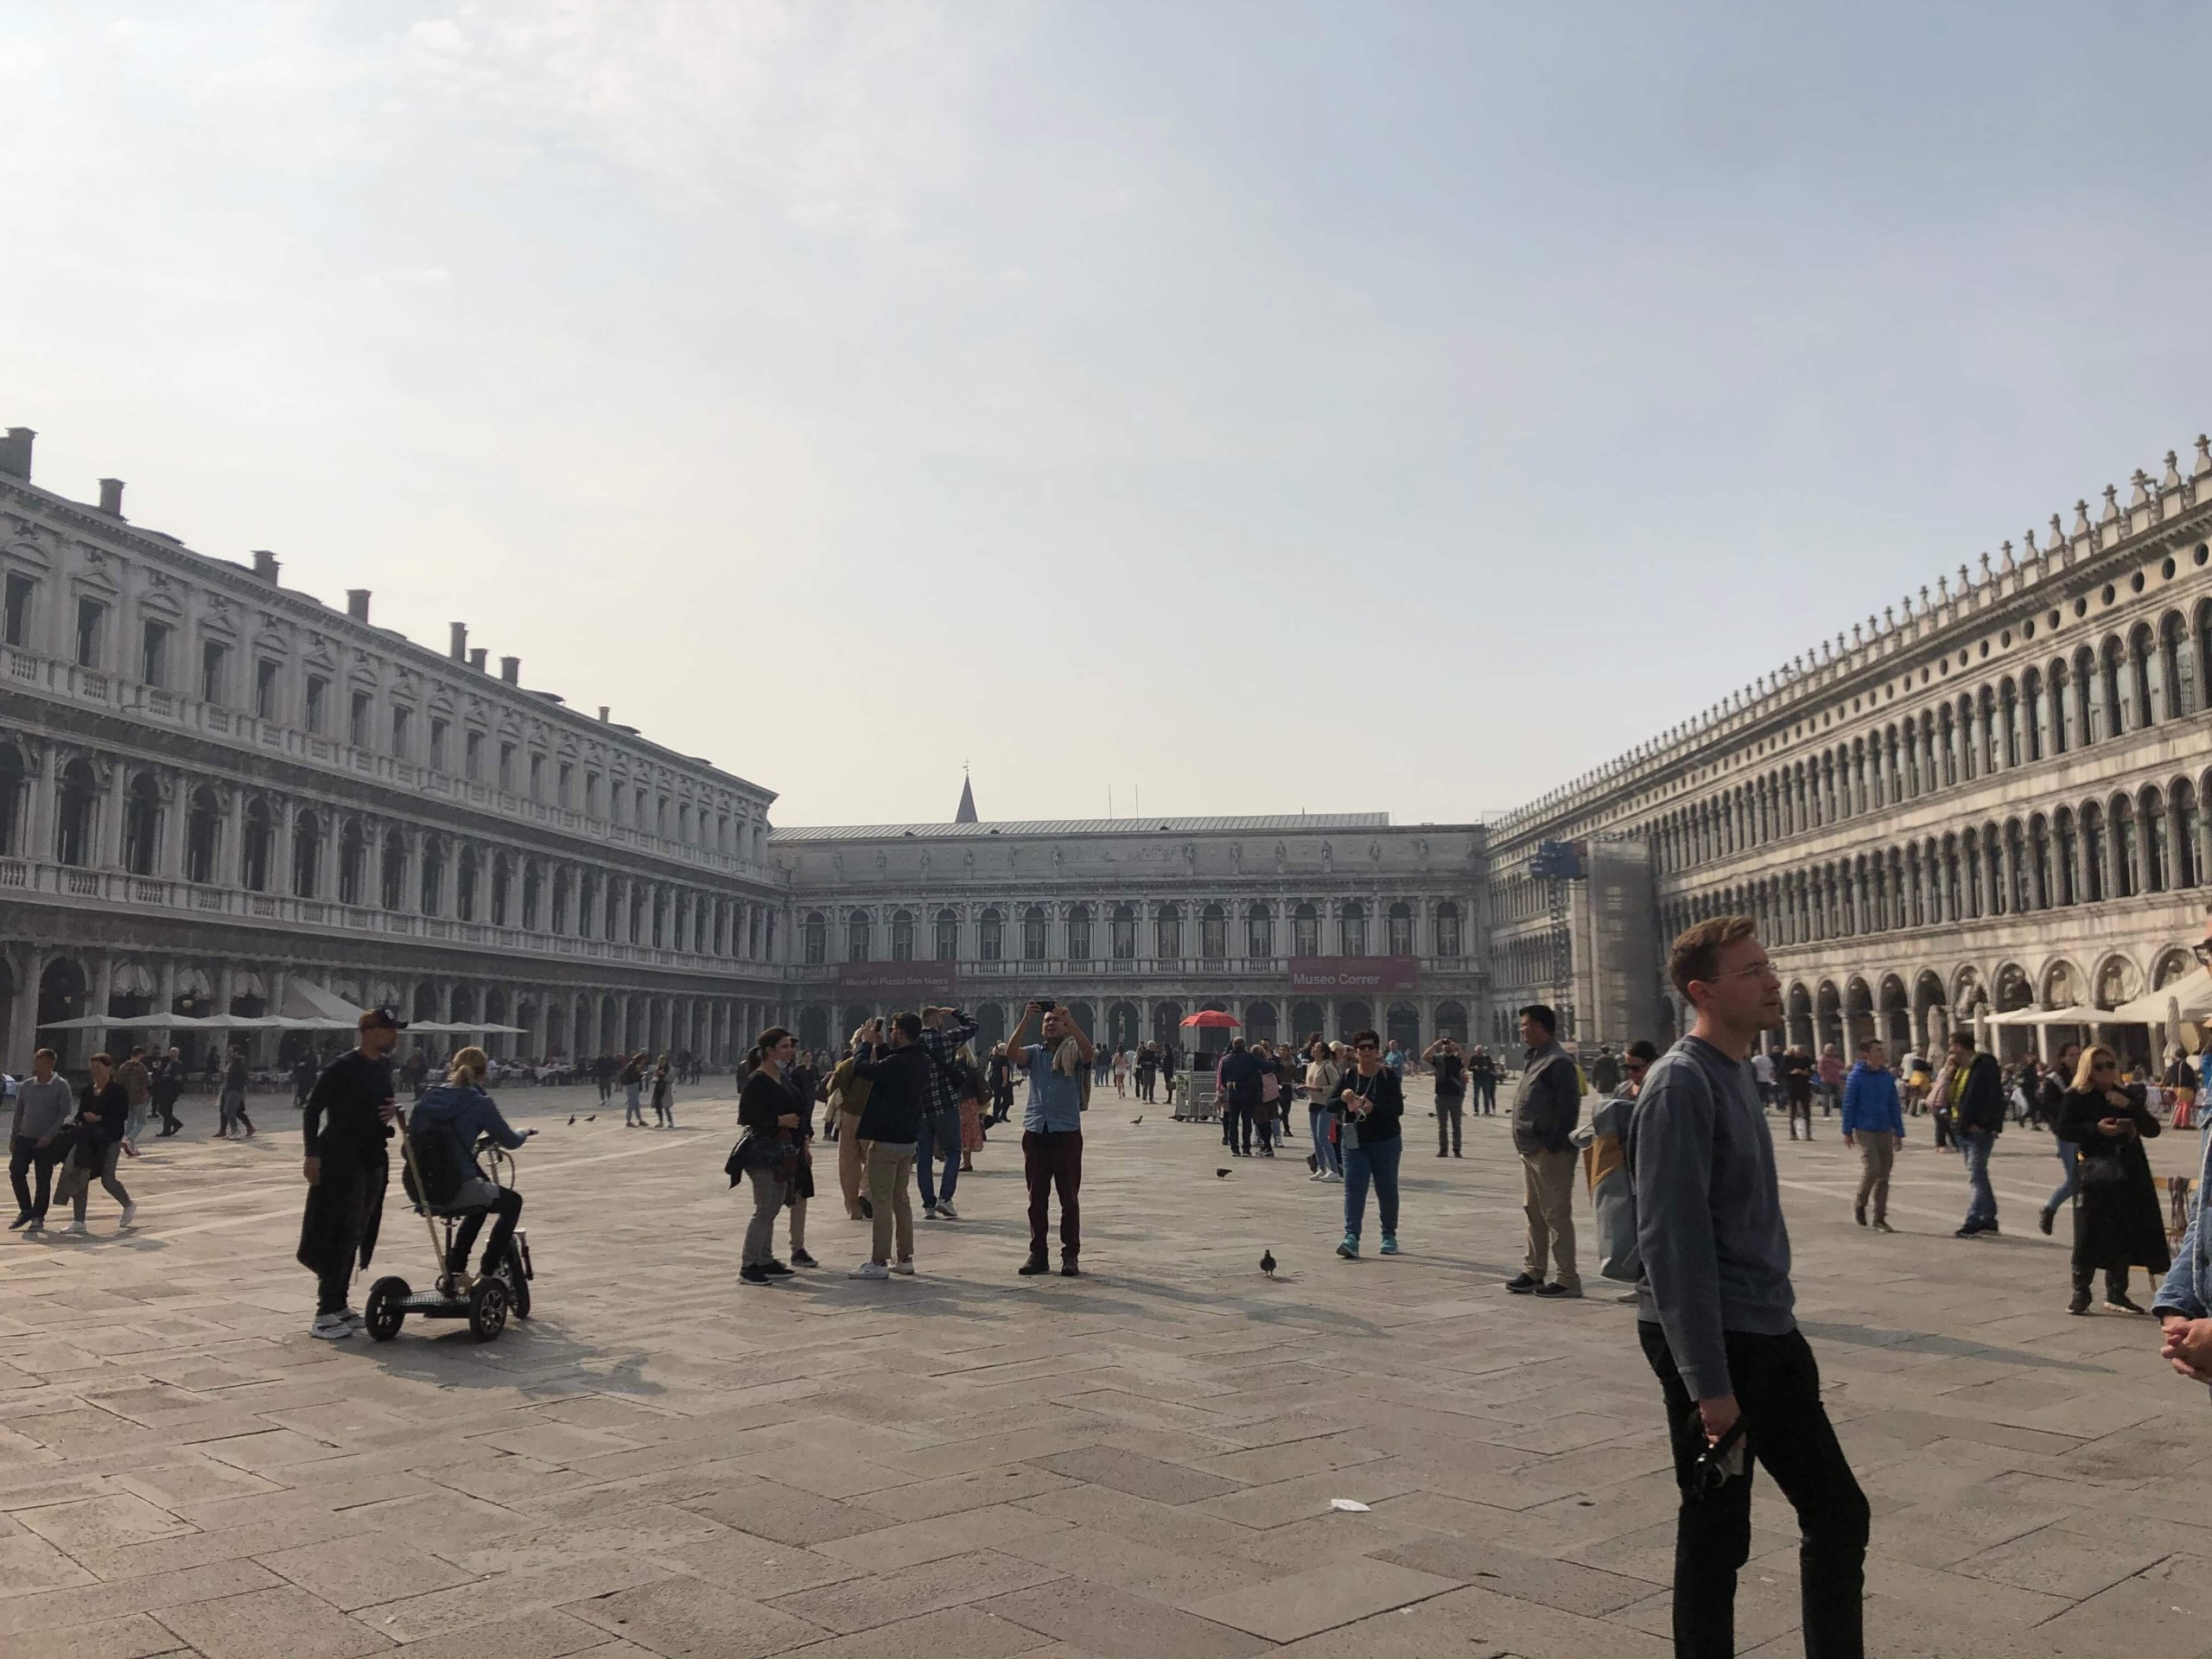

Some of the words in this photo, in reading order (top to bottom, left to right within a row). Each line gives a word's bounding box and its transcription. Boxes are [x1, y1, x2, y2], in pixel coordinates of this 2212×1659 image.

[880, 976, 906, 985] Piazza
[906, 976, 923, 985] San
[924, 976, 949, 985] Marco
[1293, 973, 1335, 985] Museo
[1338, 973, 1381, 985] Correr
